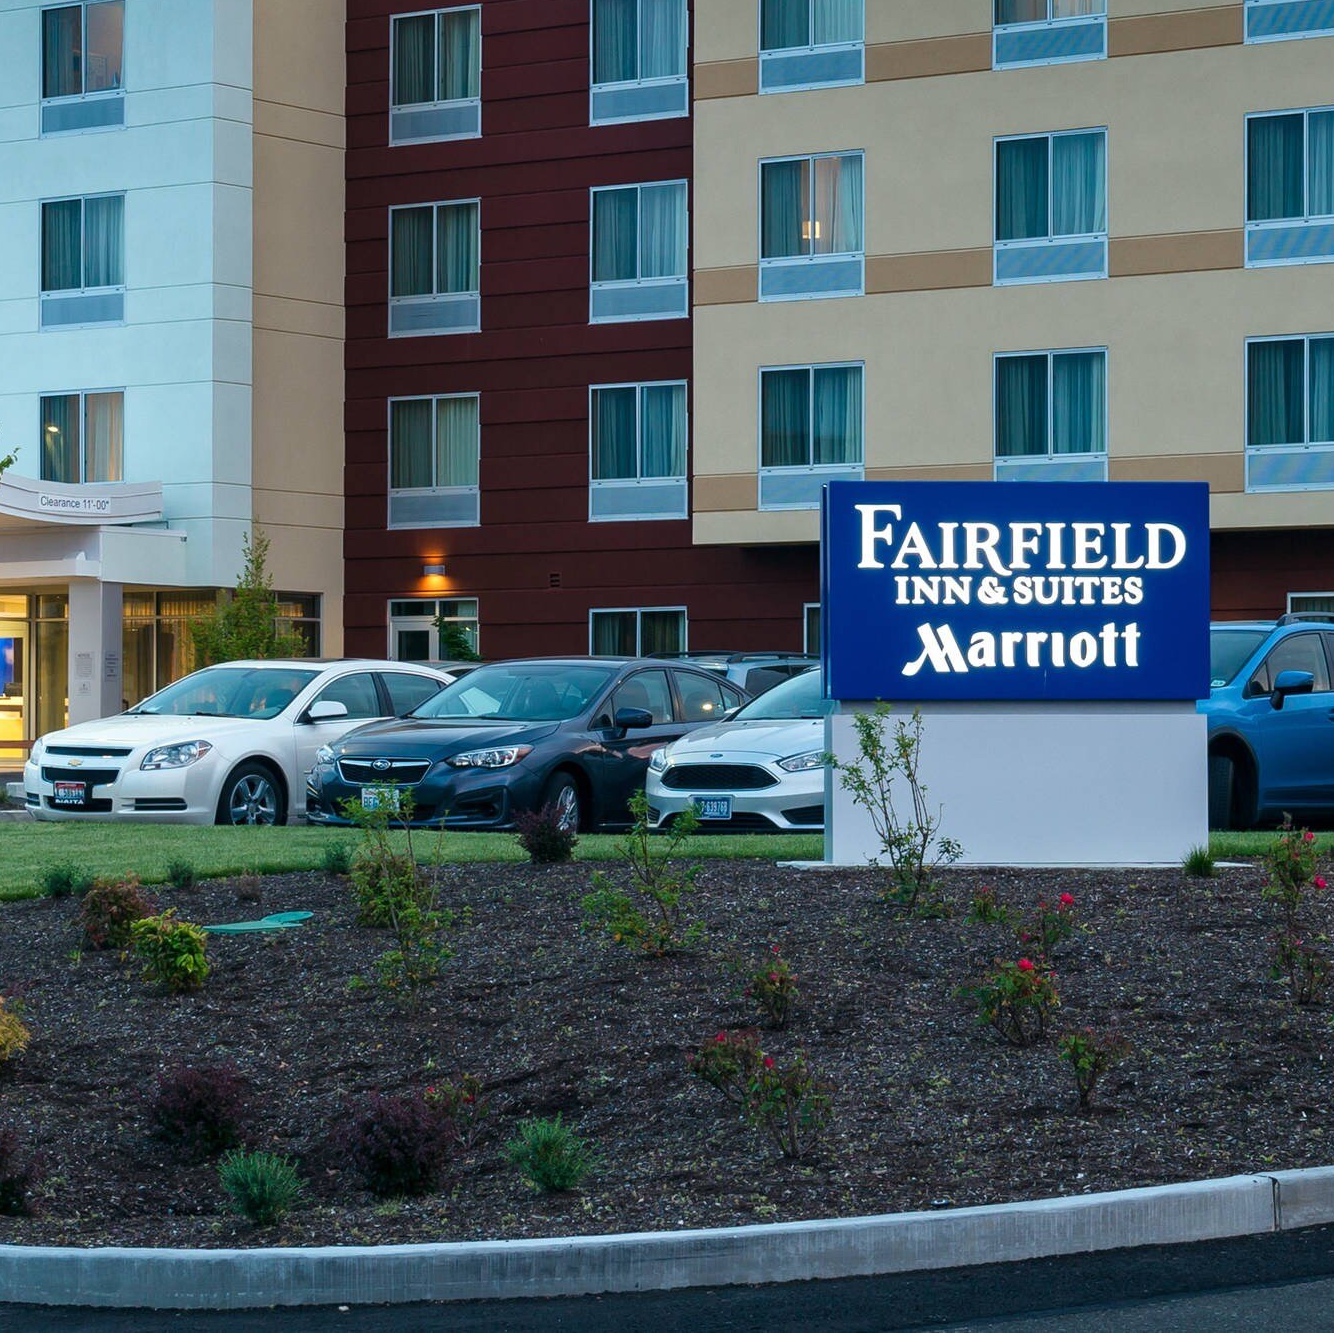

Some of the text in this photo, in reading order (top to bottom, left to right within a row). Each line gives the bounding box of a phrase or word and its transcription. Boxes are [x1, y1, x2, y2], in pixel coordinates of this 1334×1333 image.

[40, 496, 80, 508] Clearance
[854, 503, 1187, 576] FAIRFIELD
[894, 575, 972, 605] INN
[1013, 575, 1144, 605] SUITES
[901, 621, 1142, 676] Marriott
